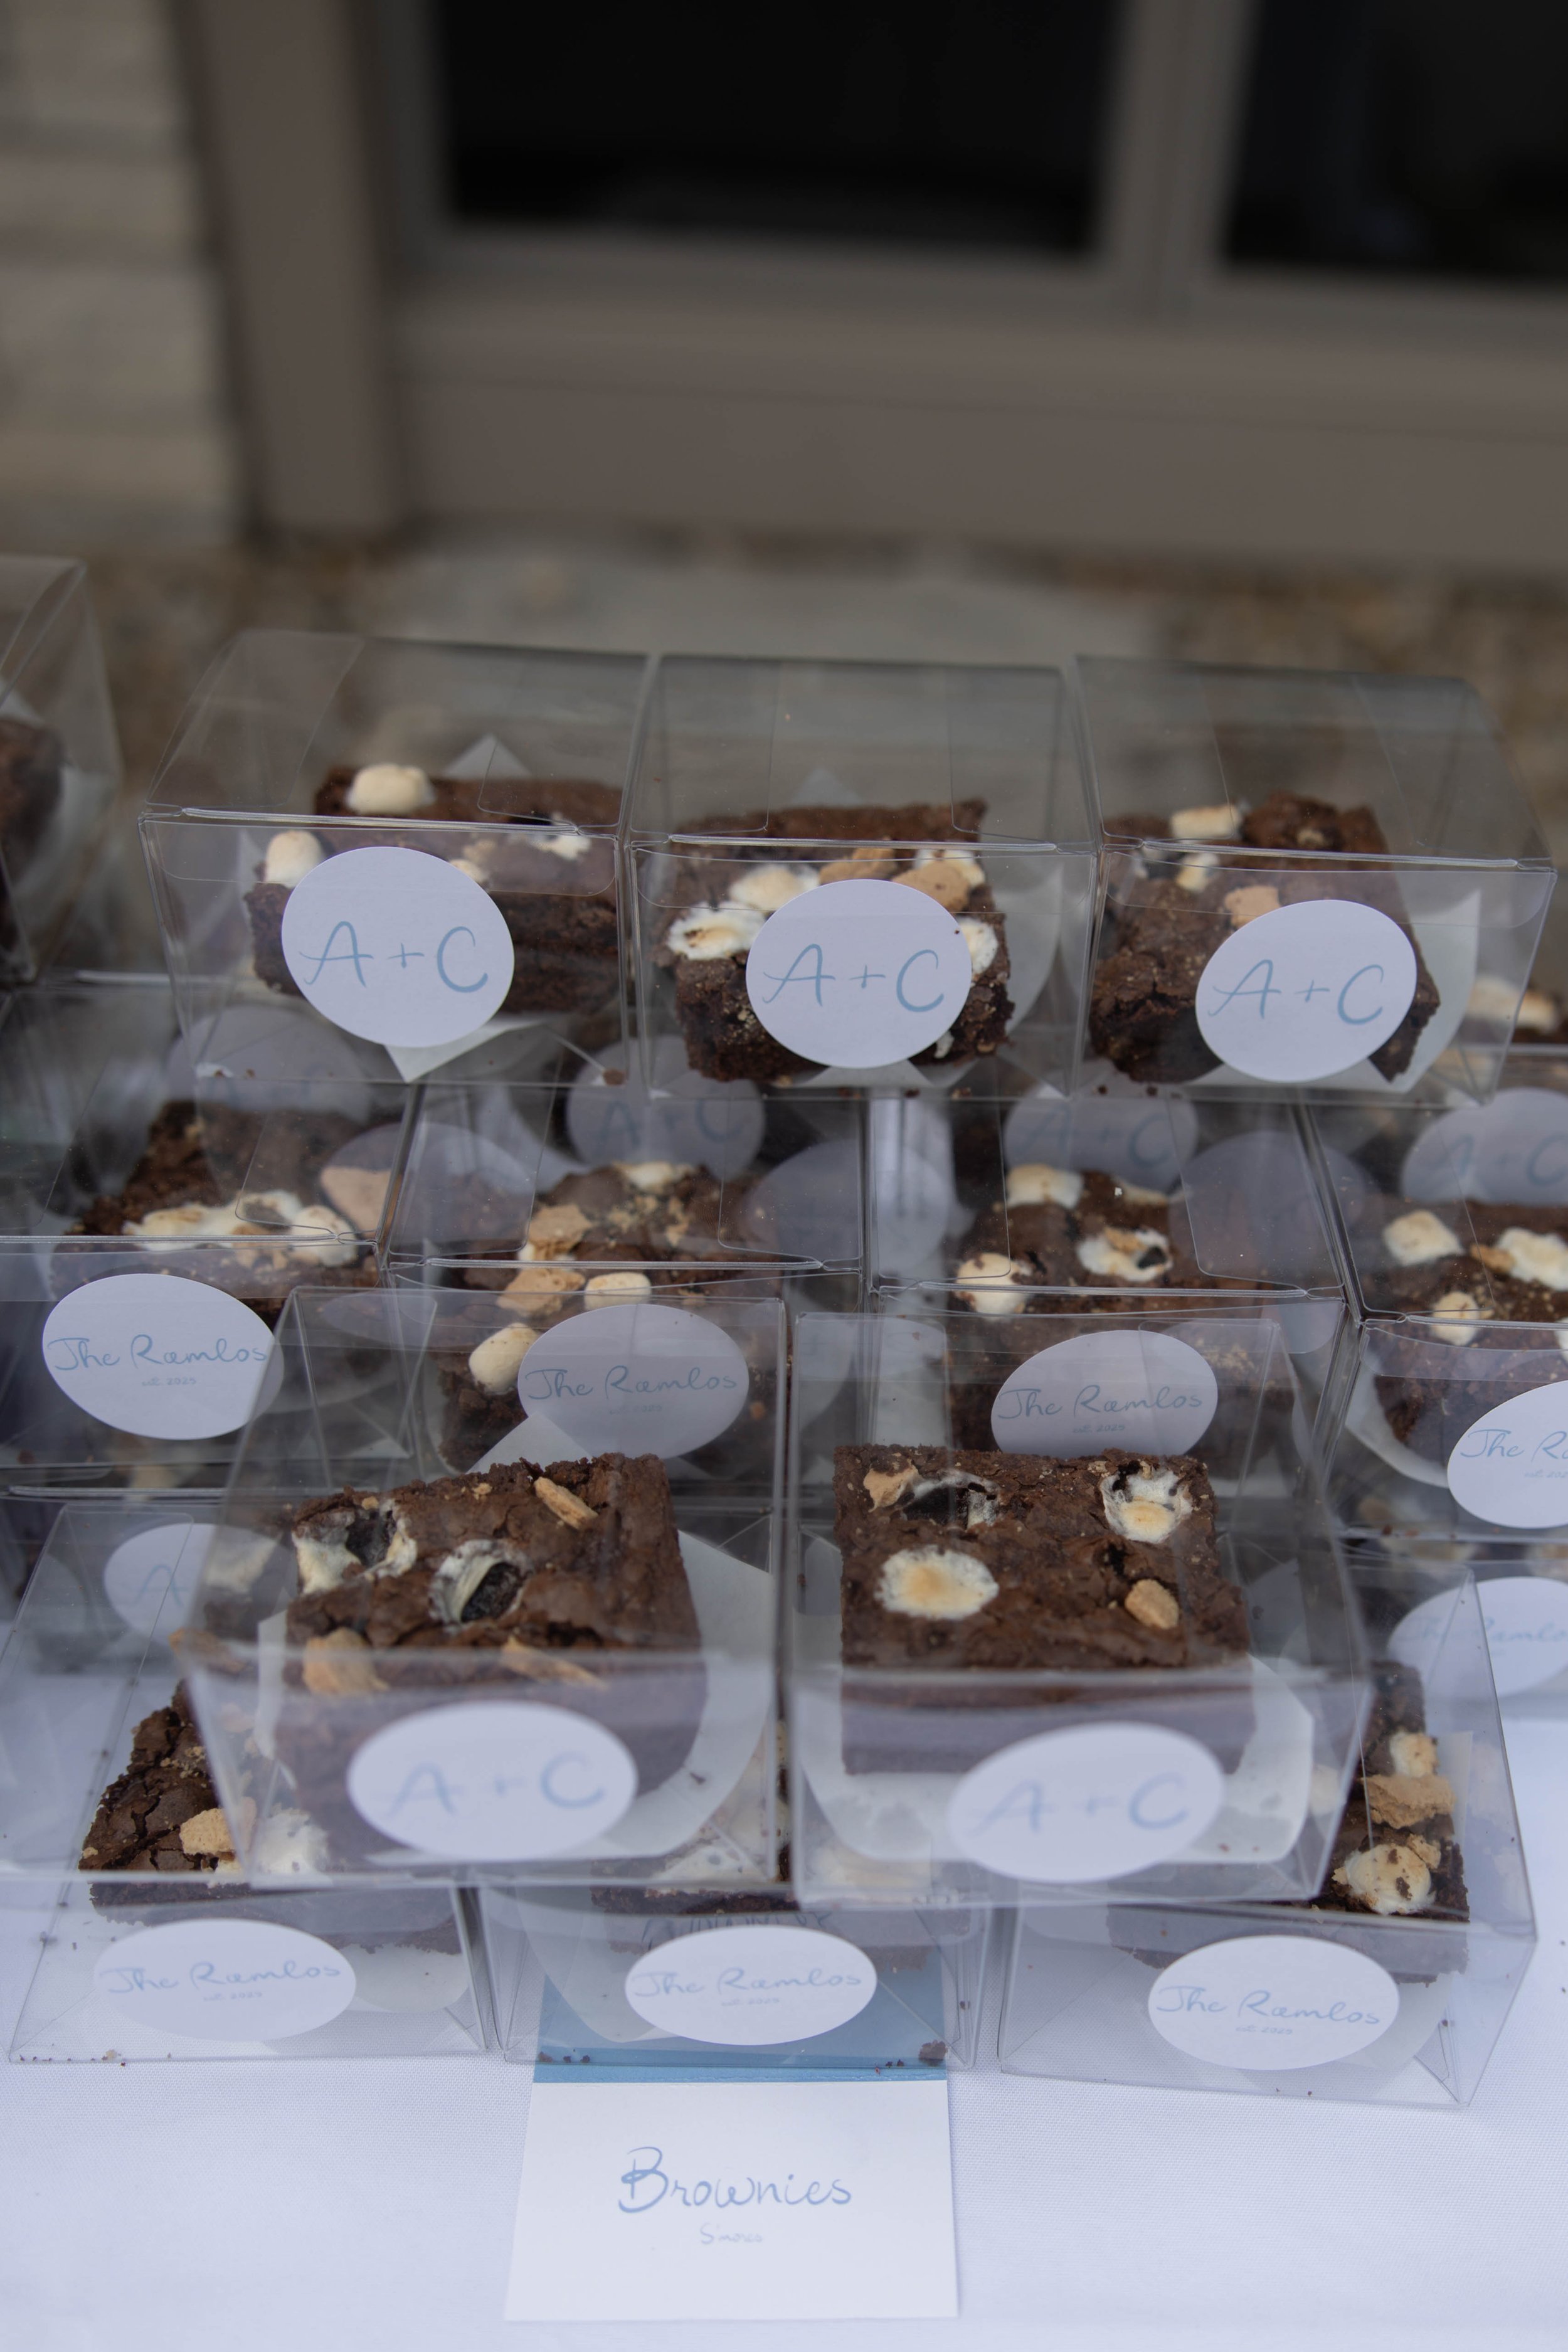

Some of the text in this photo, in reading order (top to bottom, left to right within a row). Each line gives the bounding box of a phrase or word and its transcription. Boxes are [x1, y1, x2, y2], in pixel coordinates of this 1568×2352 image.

[47, 1334, 268, 1371] The Ramlos
[524, 1365, 738, 1400] The Ramlos
[998, 1384, 1203, 1419] The Ramlos
[1459, 1428, 1525, 1458] The
[99, 1959, 341, 1994] The Ramlos
[631, 1966, 862, 1998] The Ramlos
[1155, 1984, 1380, 2025] The Ramlos
[618, 2146, 853, 2213] Brownies
